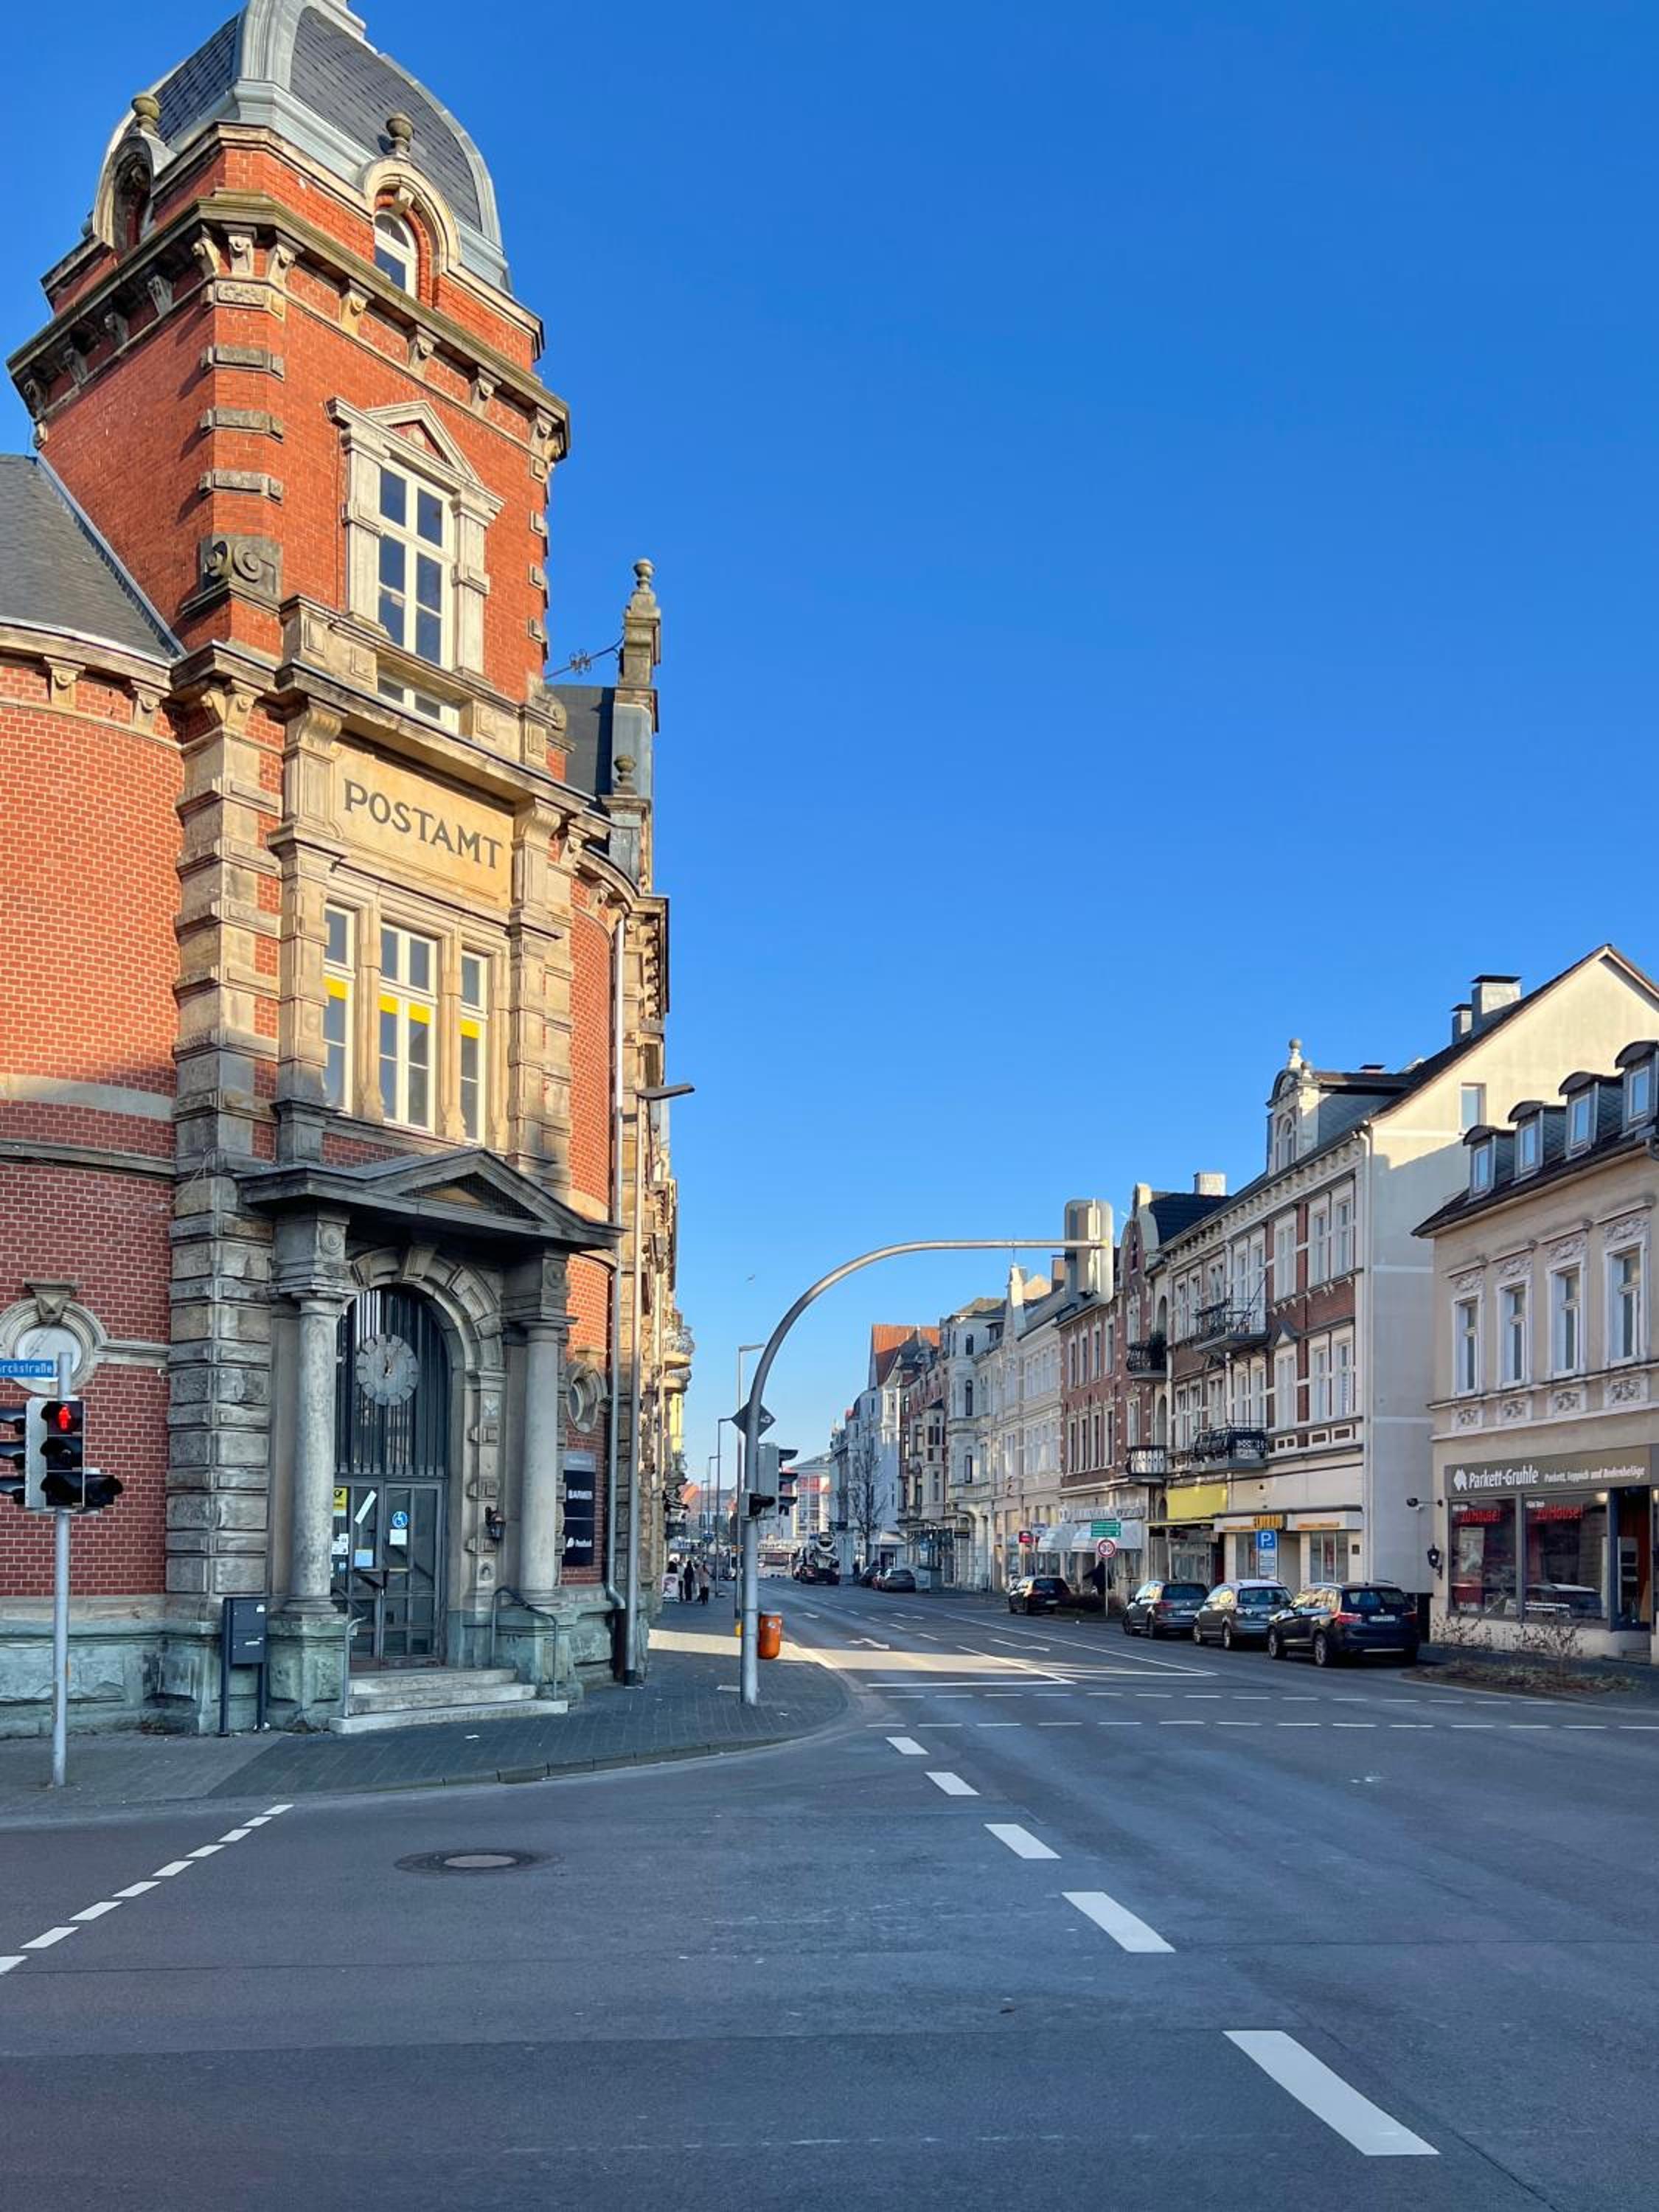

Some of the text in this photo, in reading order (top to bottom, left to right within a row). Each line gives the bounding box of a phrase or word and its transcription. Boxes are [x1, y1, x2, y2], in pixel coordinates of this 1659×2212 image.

[344, 778, 504, 869] POSTAMT
[1469, 1464, 1539, 1489] Parkett-Gruhle
[1261, 1533, 1272, 1547] P
